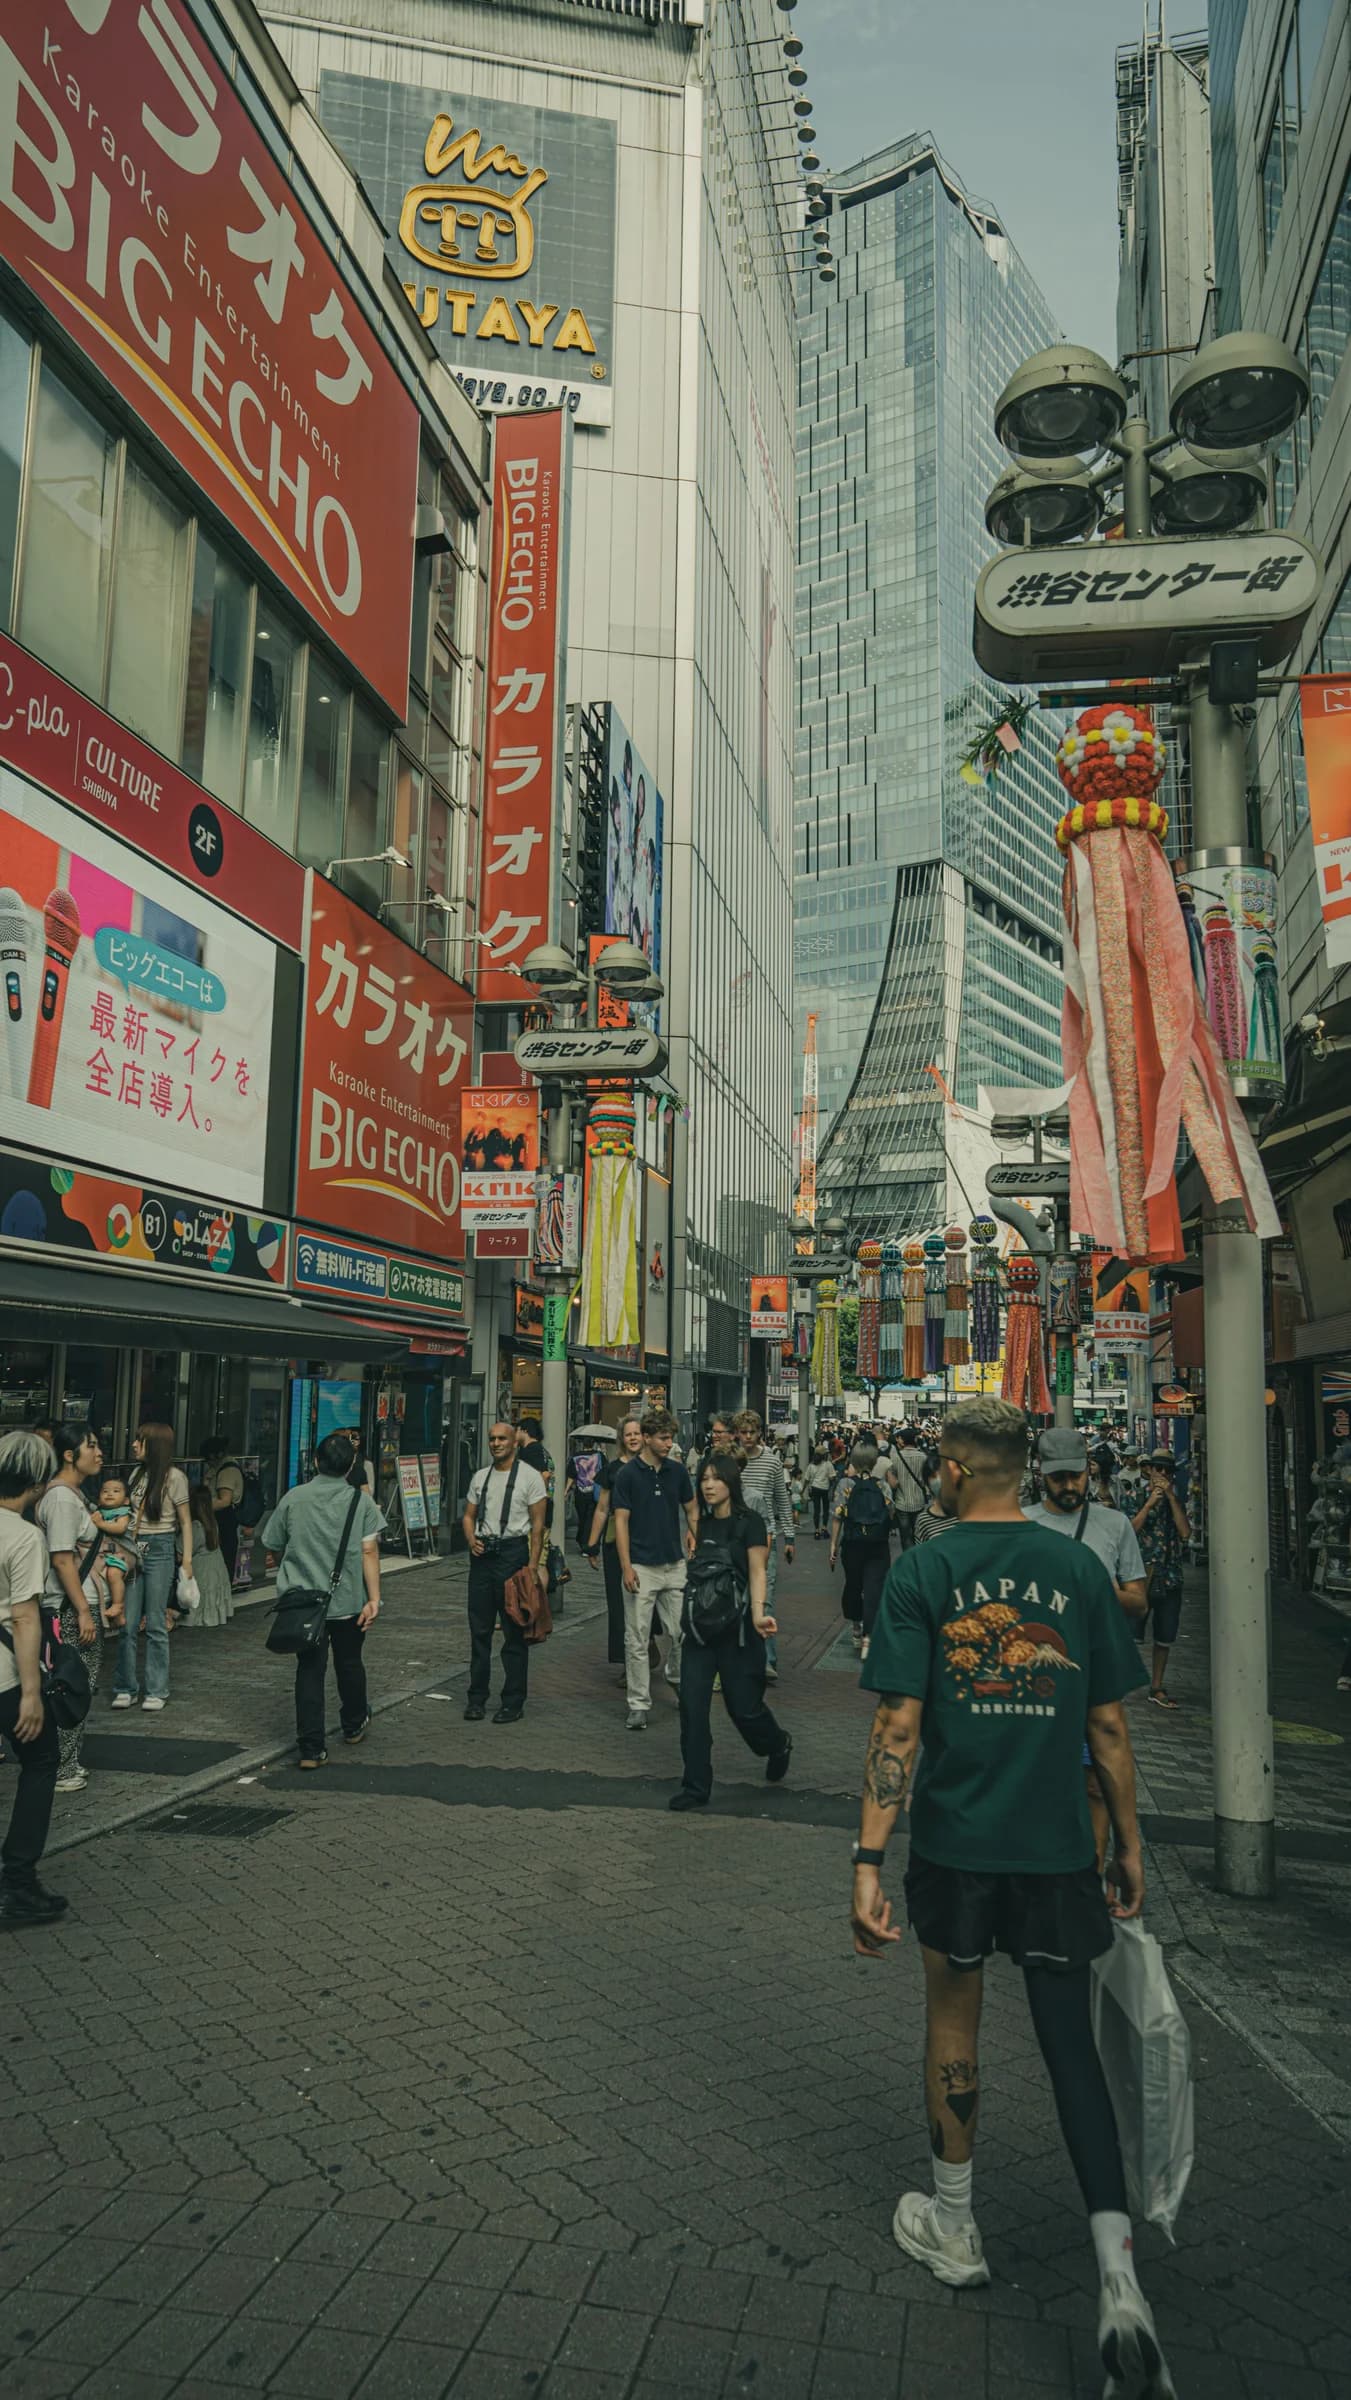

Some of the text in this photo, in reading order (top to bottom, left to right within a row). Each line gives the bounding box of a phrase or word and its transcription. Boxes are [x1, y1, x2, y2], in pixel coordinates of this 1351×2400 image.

[65, 0, 373, 406] ラオケ
[42, 26, 342, 480] Karaoke Entertainment
[0, 34, 363, 616] BIG ECHO
[501, 457, 539, 631] BIG ECHO
[539, 470, 553, 611] Karaoke Entertainment
[997, 555, 1304, 608] 渋谷センター街
[0, 662, 69, 737] C-pla
[82, 776, 118, 811] SHIBUYA
[85, 736, 163, 812] CULTURE
[194, 825, 217, 855] 2F
[483, 667, 547, 958] カラオケ
[90, 990, 250, 1096] 最新マイクを
[314, 940, 468, 1086] カラオケ
[521, 1038, 649, 1058] 渋谷センター街
[85, 1047, 213, 1132] 全店導入。
[329, 1060, 451, 1139] Karaoke Entertainment
[309, 1088, 460, 1216] BIG ECHO
[991, 1171, 1070, 1184] 渋谷センター
[145, 1214, 160, 1236] B1
[488, 1236, 517, 1245] シープラ
[317, 1249, 386, 1288] 無料Wi-Fi完備
[402, 1271, 462, 1303] スマホ充電器完備
[953, 1578, 1070, 1614] JAPAN
